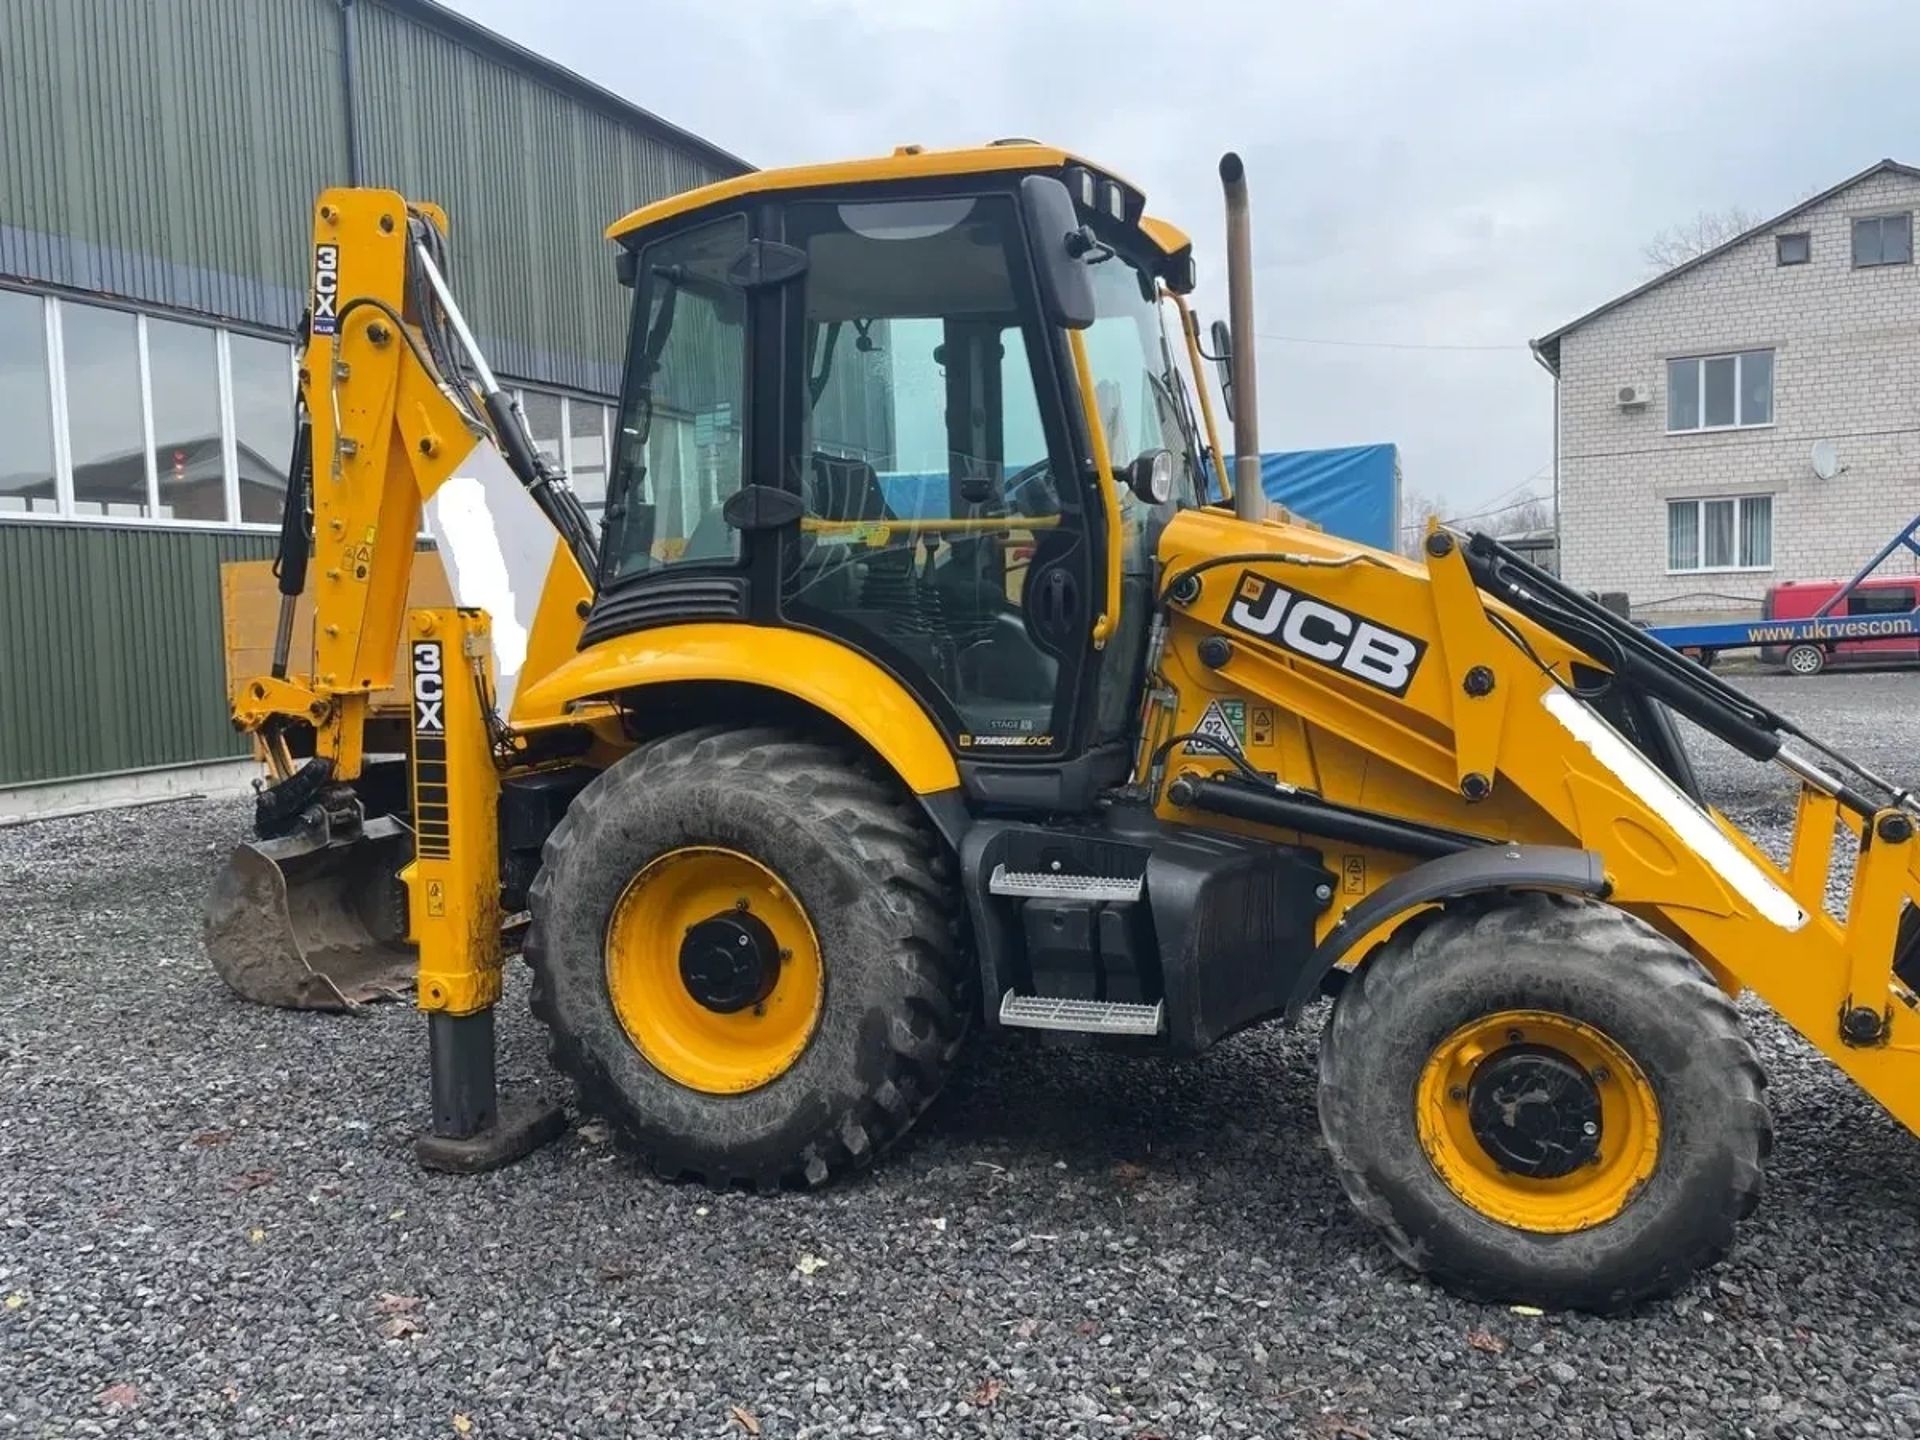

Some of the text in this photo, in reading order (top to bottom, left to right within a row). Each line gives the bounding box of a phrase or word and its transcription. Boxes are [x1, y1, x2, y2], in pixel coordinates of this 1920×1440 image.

[315, 246, 337, 317] 3CX
[1231, 589, 1416, 688] JCB
[415, 644, 444, 729] 3CX
[974, 736, 1053, 746] TORQUELOCK
[1205, 721, 1221, 735] 92
